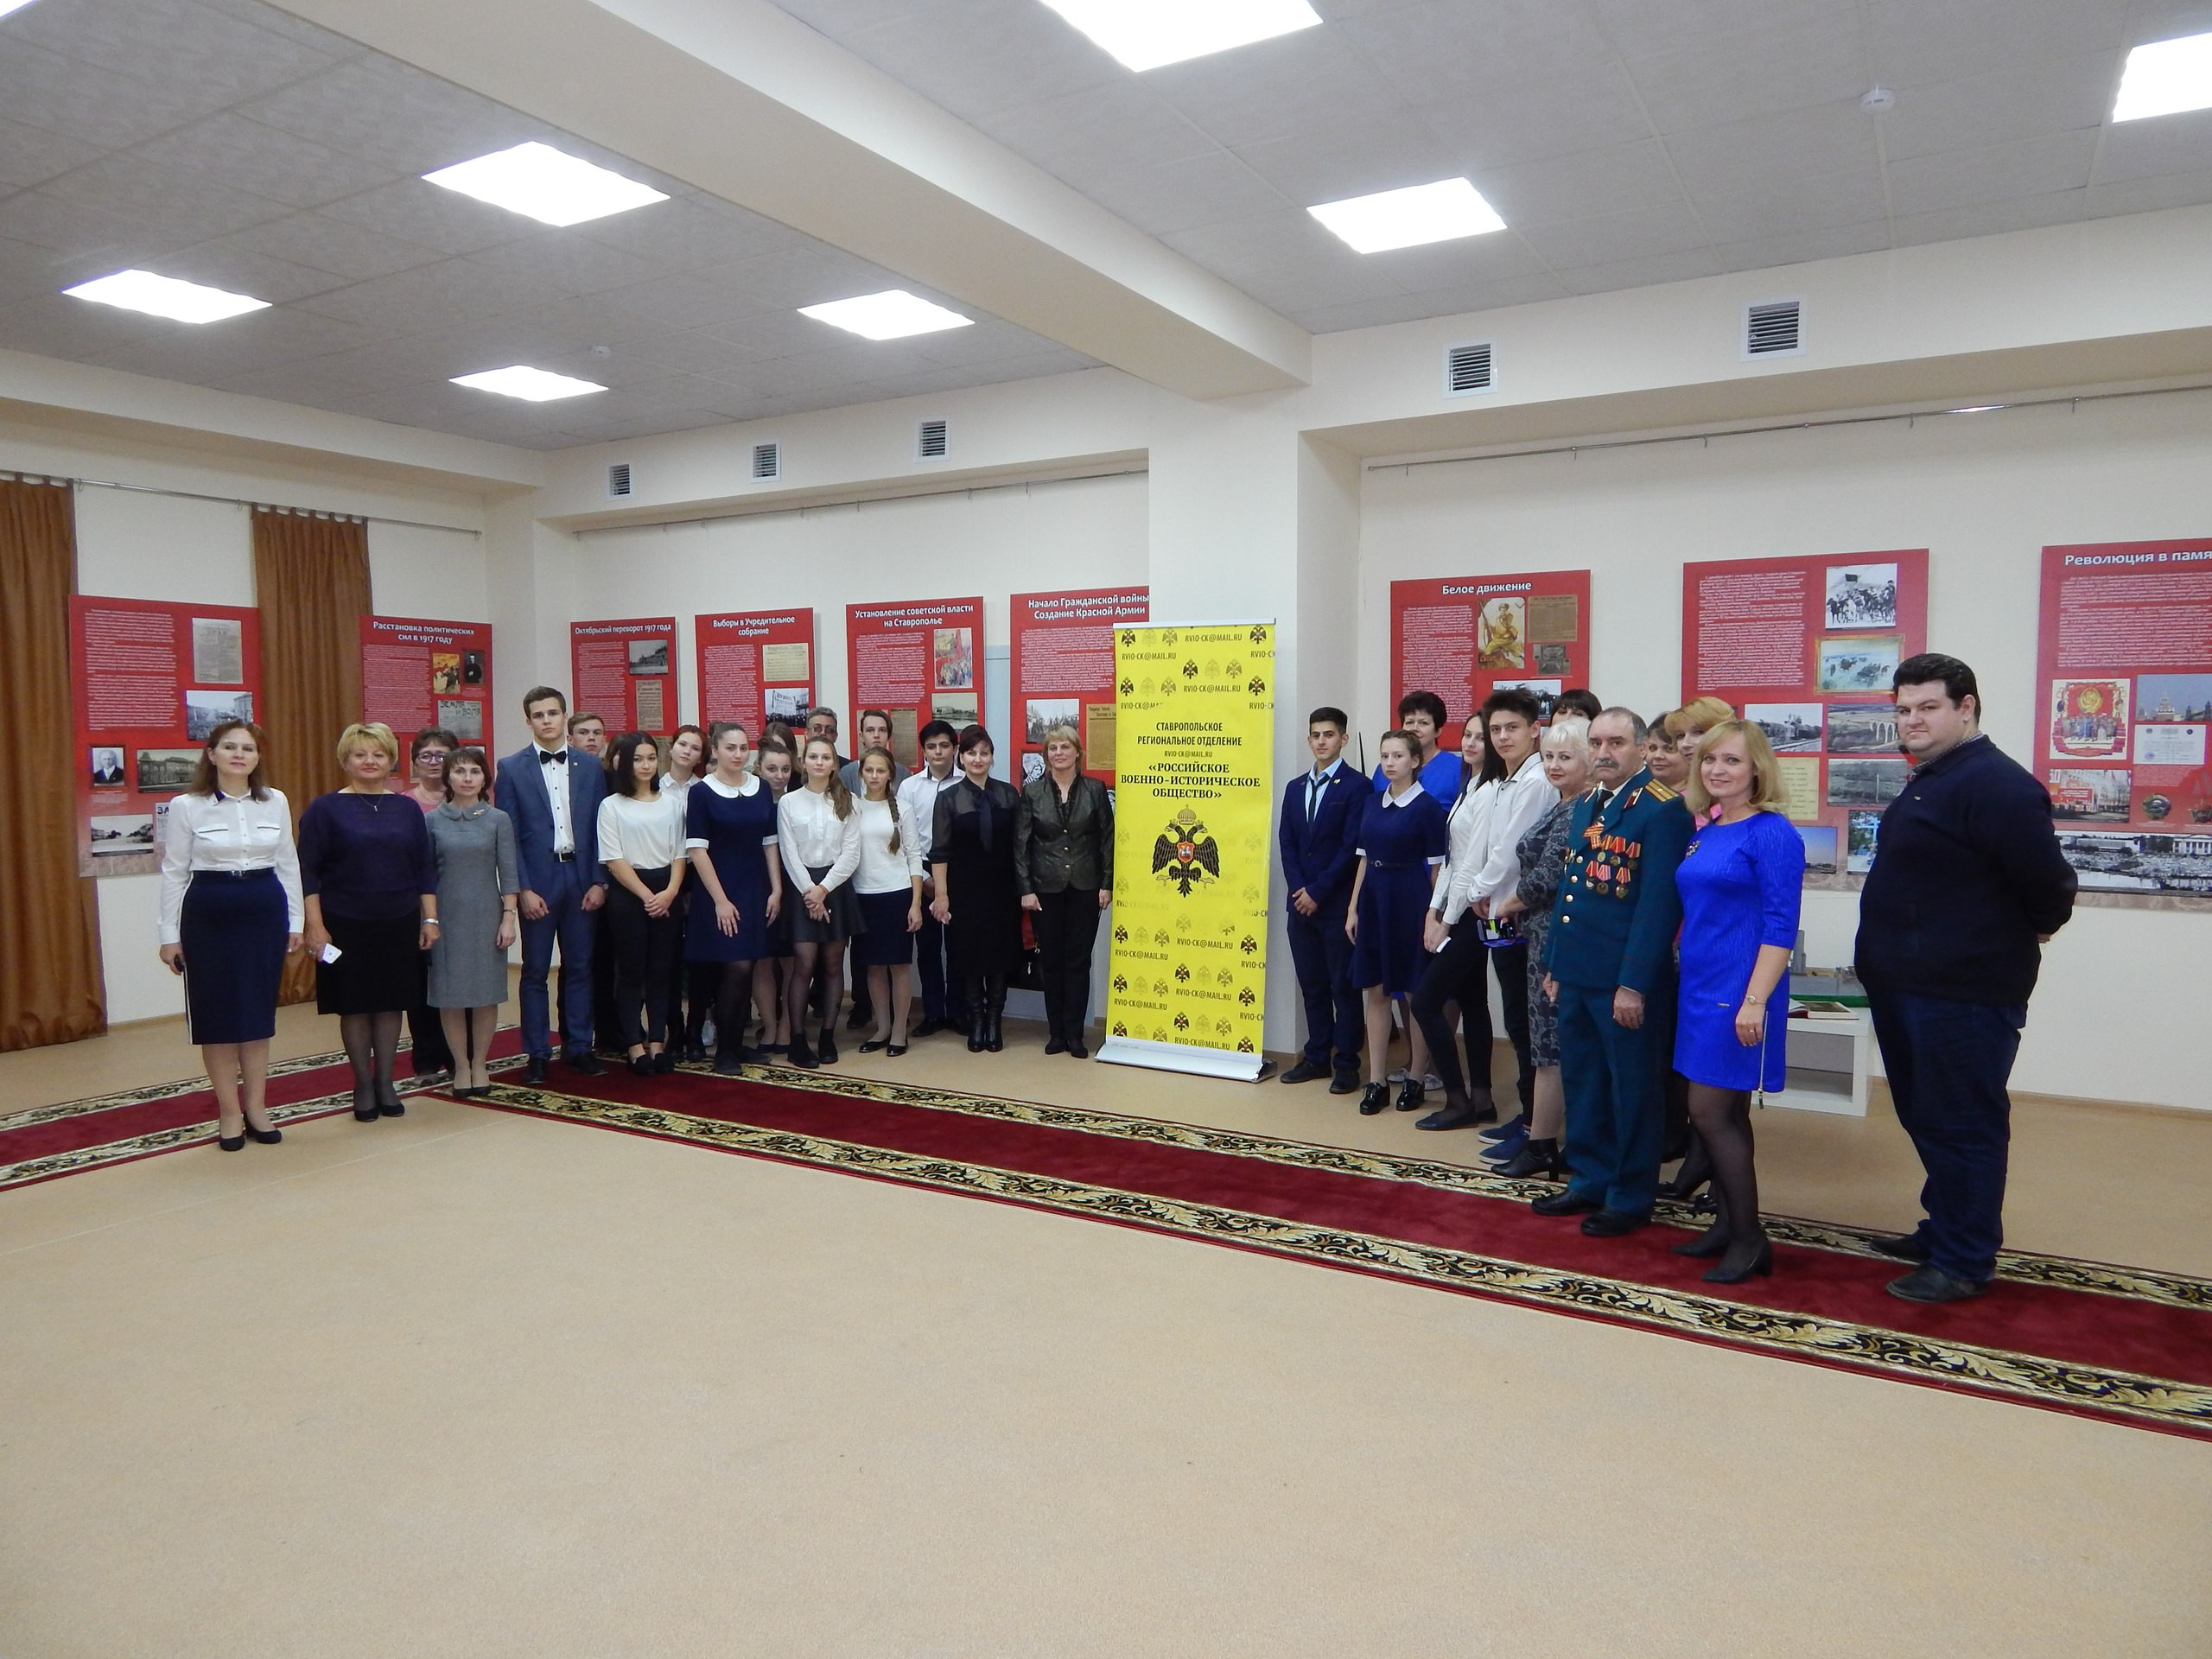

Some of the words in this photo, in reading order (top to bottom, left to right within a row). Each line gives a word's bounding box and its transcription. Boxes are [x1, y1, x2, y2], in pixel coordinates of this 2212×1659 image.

[2064, 552, 2154, 566] Революция
[2158, 553, 2167, 562] в
[2171, 550, 2212, 562] памя
[1442, 585, 1474, 594] Белое
[1476, 582, 1532, 595] движение
[1028, 599, 1058, 608] Начало
[1060, 594, 1119, 608] Гражданской
[1120, 593, 1149, 603] войны
[855, 608, 906, 619] Установление
[906, 604, 946, 616] советской
[947, 604, 974, 613] власти
[1034, 608, 1074, 620] Создание
[1076, 606, 1113, 619] Красной
[1115, 606, 1146, 618] Армии
[373, 621, 423, 632] Расстановка
[423, 626, 474, 635] политических
[713, 620, 740, 628] Выборы
[745, 616, 795, 626] Учредительное
[893, 617, 943, 628] Ставрополье
[575, 626, 612, 635] Октябрьский
[613, 625, 644, 634] переворот
[645, 624, 656, 632] 1917
[738, 627, 769, 637] собрание
[420, 635, 434, 644] 1917
[435, 636, 453, 645] году
[1184, 684, 1241, 693] RVIO-CK@MAIL.RU
[1156, 722, 1223, 732] СТАВРОПОЛЬСКОЕ
[1137, 735, 1195, 746] РЕГИОНАЛЬНОЕ
[1197, 736, 1243, 747] ОТДЕЛЕНИЕ
[1121, 774, 1261, 787] ВОЕННО-ИСТОРИЧЕСКОЕ
[1177, 938, 1234, 950] RVIO-CK@MAIL.RU
[1115, 949, 1168, 961] RVIO-CK@MAIL.RU
[1176, 988, 1232, 1001] RVIO-CK@MAIL.RU
[1114, 998, 1167, 1011] RVIO-CK@MAIL.RU
